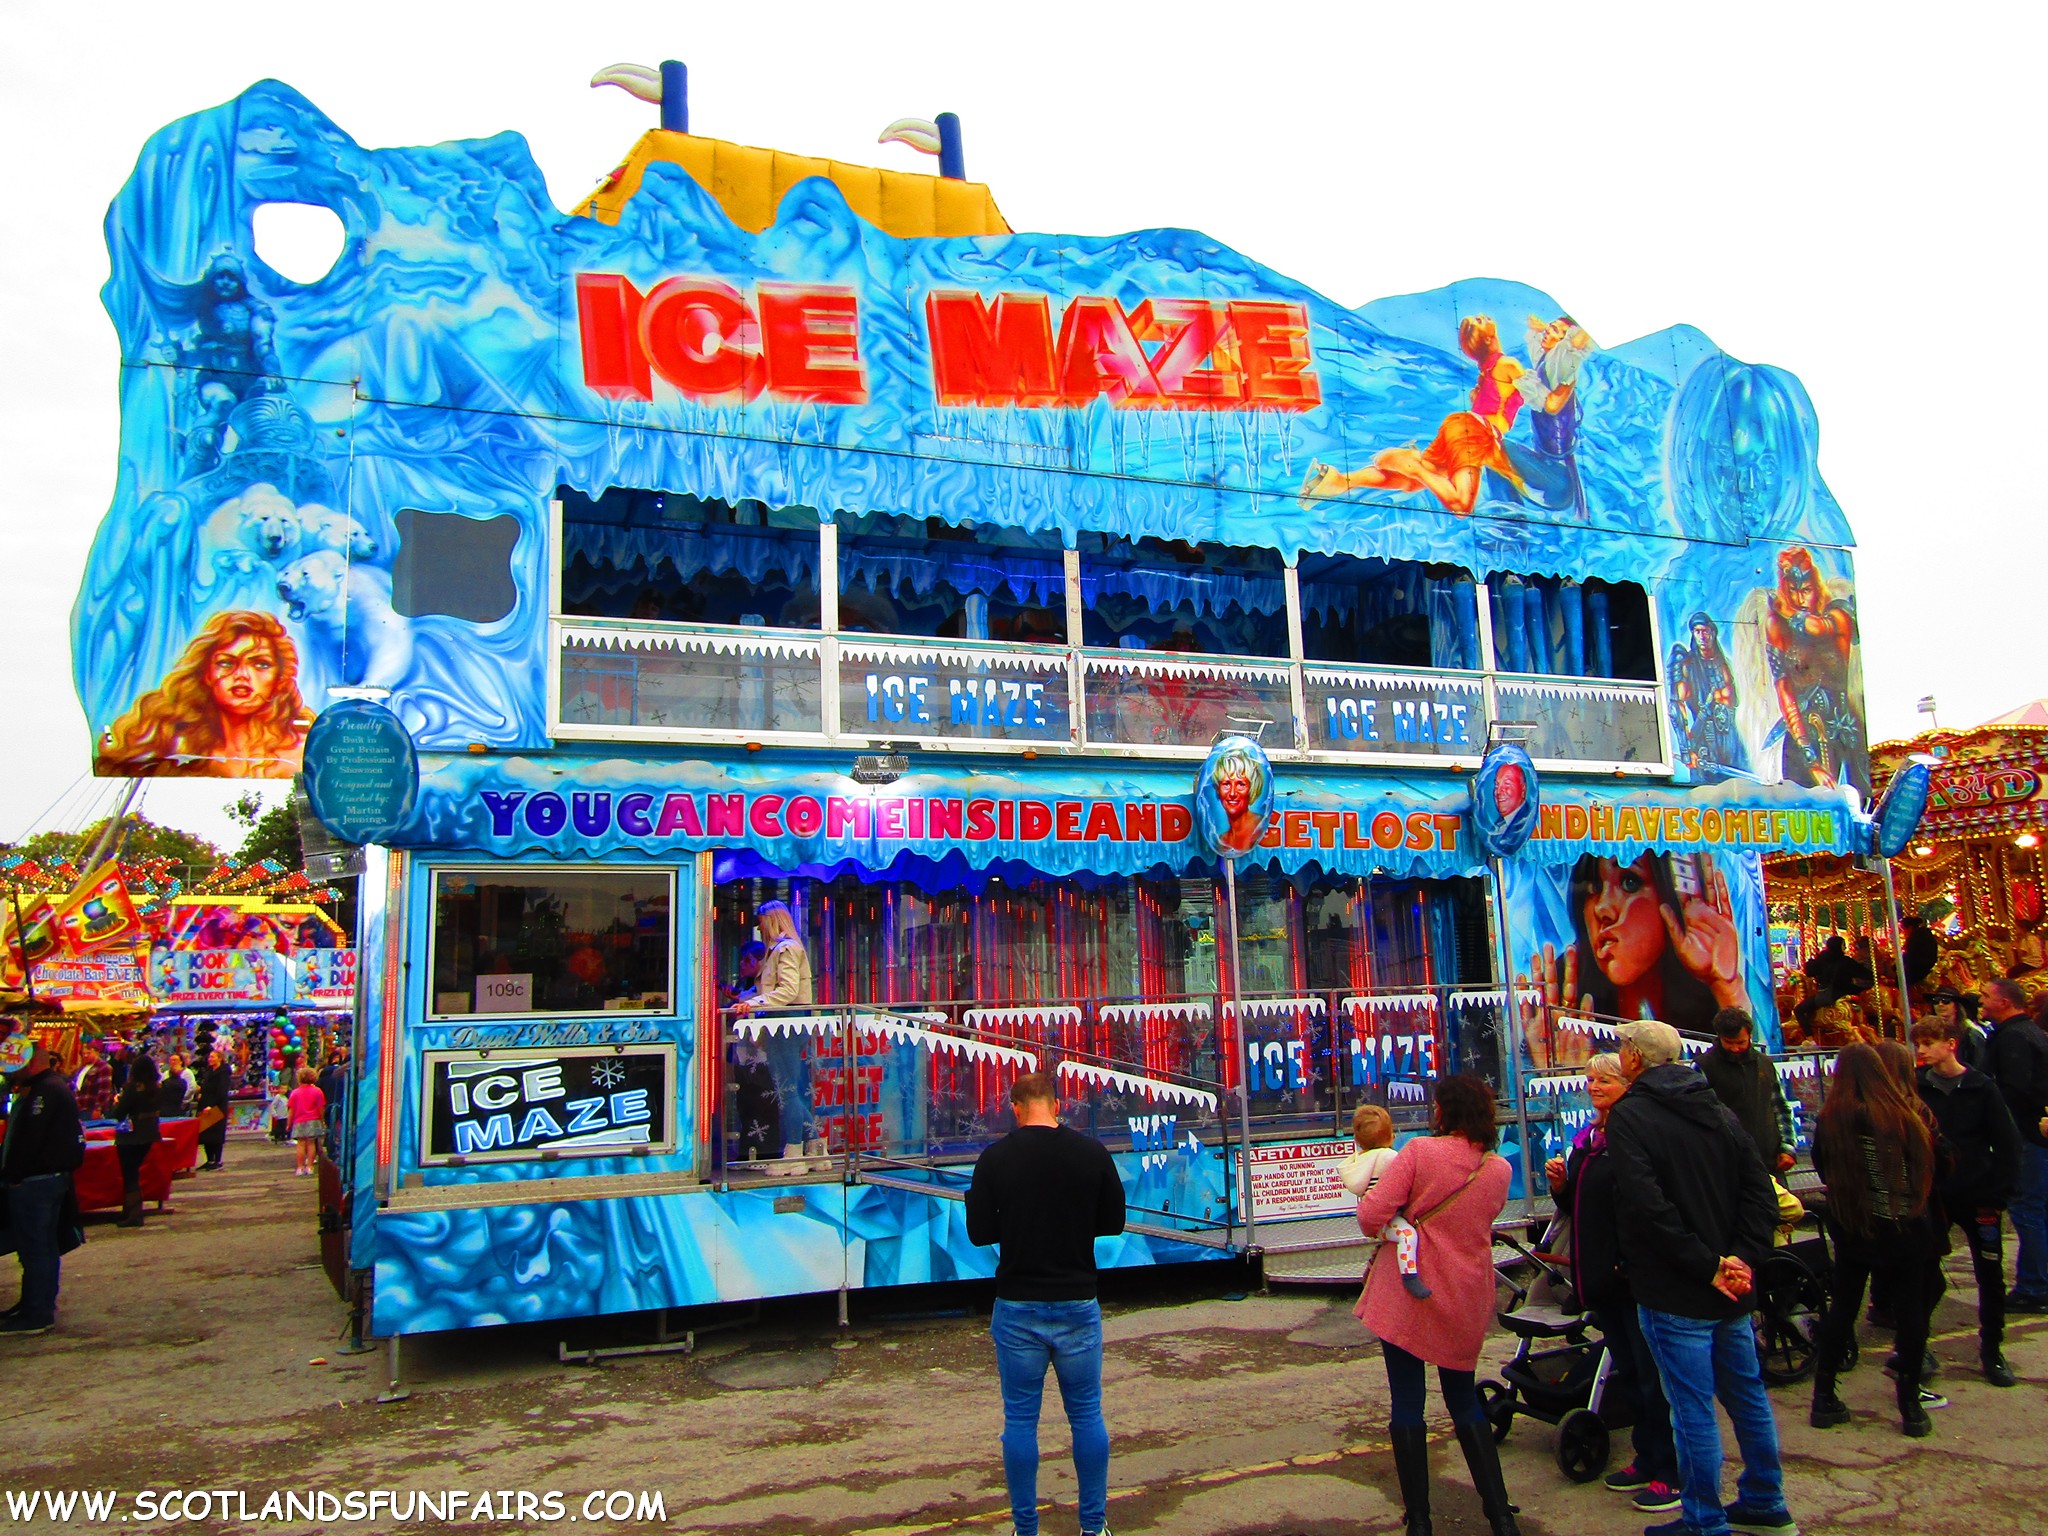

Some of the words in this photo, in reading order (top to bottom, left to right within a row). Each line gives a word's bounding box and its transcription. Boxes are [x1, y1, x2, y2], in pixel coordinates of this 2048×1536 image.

[575, 272, 870, 403] ICE
[926, 290, 1322, 414] MAZE
[866, 674, 930, 724] ICE
[949, 678, 1046, 728] MAZE
[1327, 696, 1379, 741] ICE
[1392, 700, 1470, 745] MAZE
[346, 806, 381, 815] Martin
[342, 814, 387, 825] Jennings
[106, 967, 142, 982] EVER
[188, 972, 236, 989] DUCK
[171, 991, 198, 1001] PRIZE
[198, 991, 227, 1000] EVERY
[227, 990, 249, 1000] TIME
[313, 988, 337, 997] PRIZE
[485, 983, 525, 998] 109c
[450, 1026, 525, 1049] David
[526, 1022, 590, 1046] Wallis
[595, 1023, 615, 1043] &
[618, 1021, 661, 1042] Son
[1248, 1041, 1307, 1091] ICE
[1350, 1034, 1437, 1086] MAZE
[450, 1066, 566, 1116] ICE
[455, 1089, 652, 1154] MAZE
[1128, 1114, 1177, 1152] WAY
[1300, 1142, 1354, 1158] NOTICE
[1141, 1153, 1169, 1189] IN
[1279, 1163, 1289, 1171] NO
[1289, 1161, 1315, 1170] RUNNING
[1251, 1174, 1263, 1182] EEP
[1264, 1172, 1285, 1180] HANDS
[1286, 1171, 1298, 1179] OUT
[1300, 1170, 1305, 1178] IN
[1306, 1169, 1324, 1177] FRONT
[1326, 1168, 1335, 1176] OF
[1253, 1181, 1269, 1190] WALK
[1271, 1179, 1303, 1188] CAREFULLY
[1314, 1176, 1324, 1184] ALL
[1262, 1187, 1290, 1197] CHILDREN
[1292, 1186, 1308, 1194] MUST
[1309, 1185, 1317, 1193] BE
[1265, 1197, 1270, 1205] A
[1271, 1194, 1311, 1205] RESPONSIBLE
[1312, 1191, 1342, 1201] GUARDIAN
